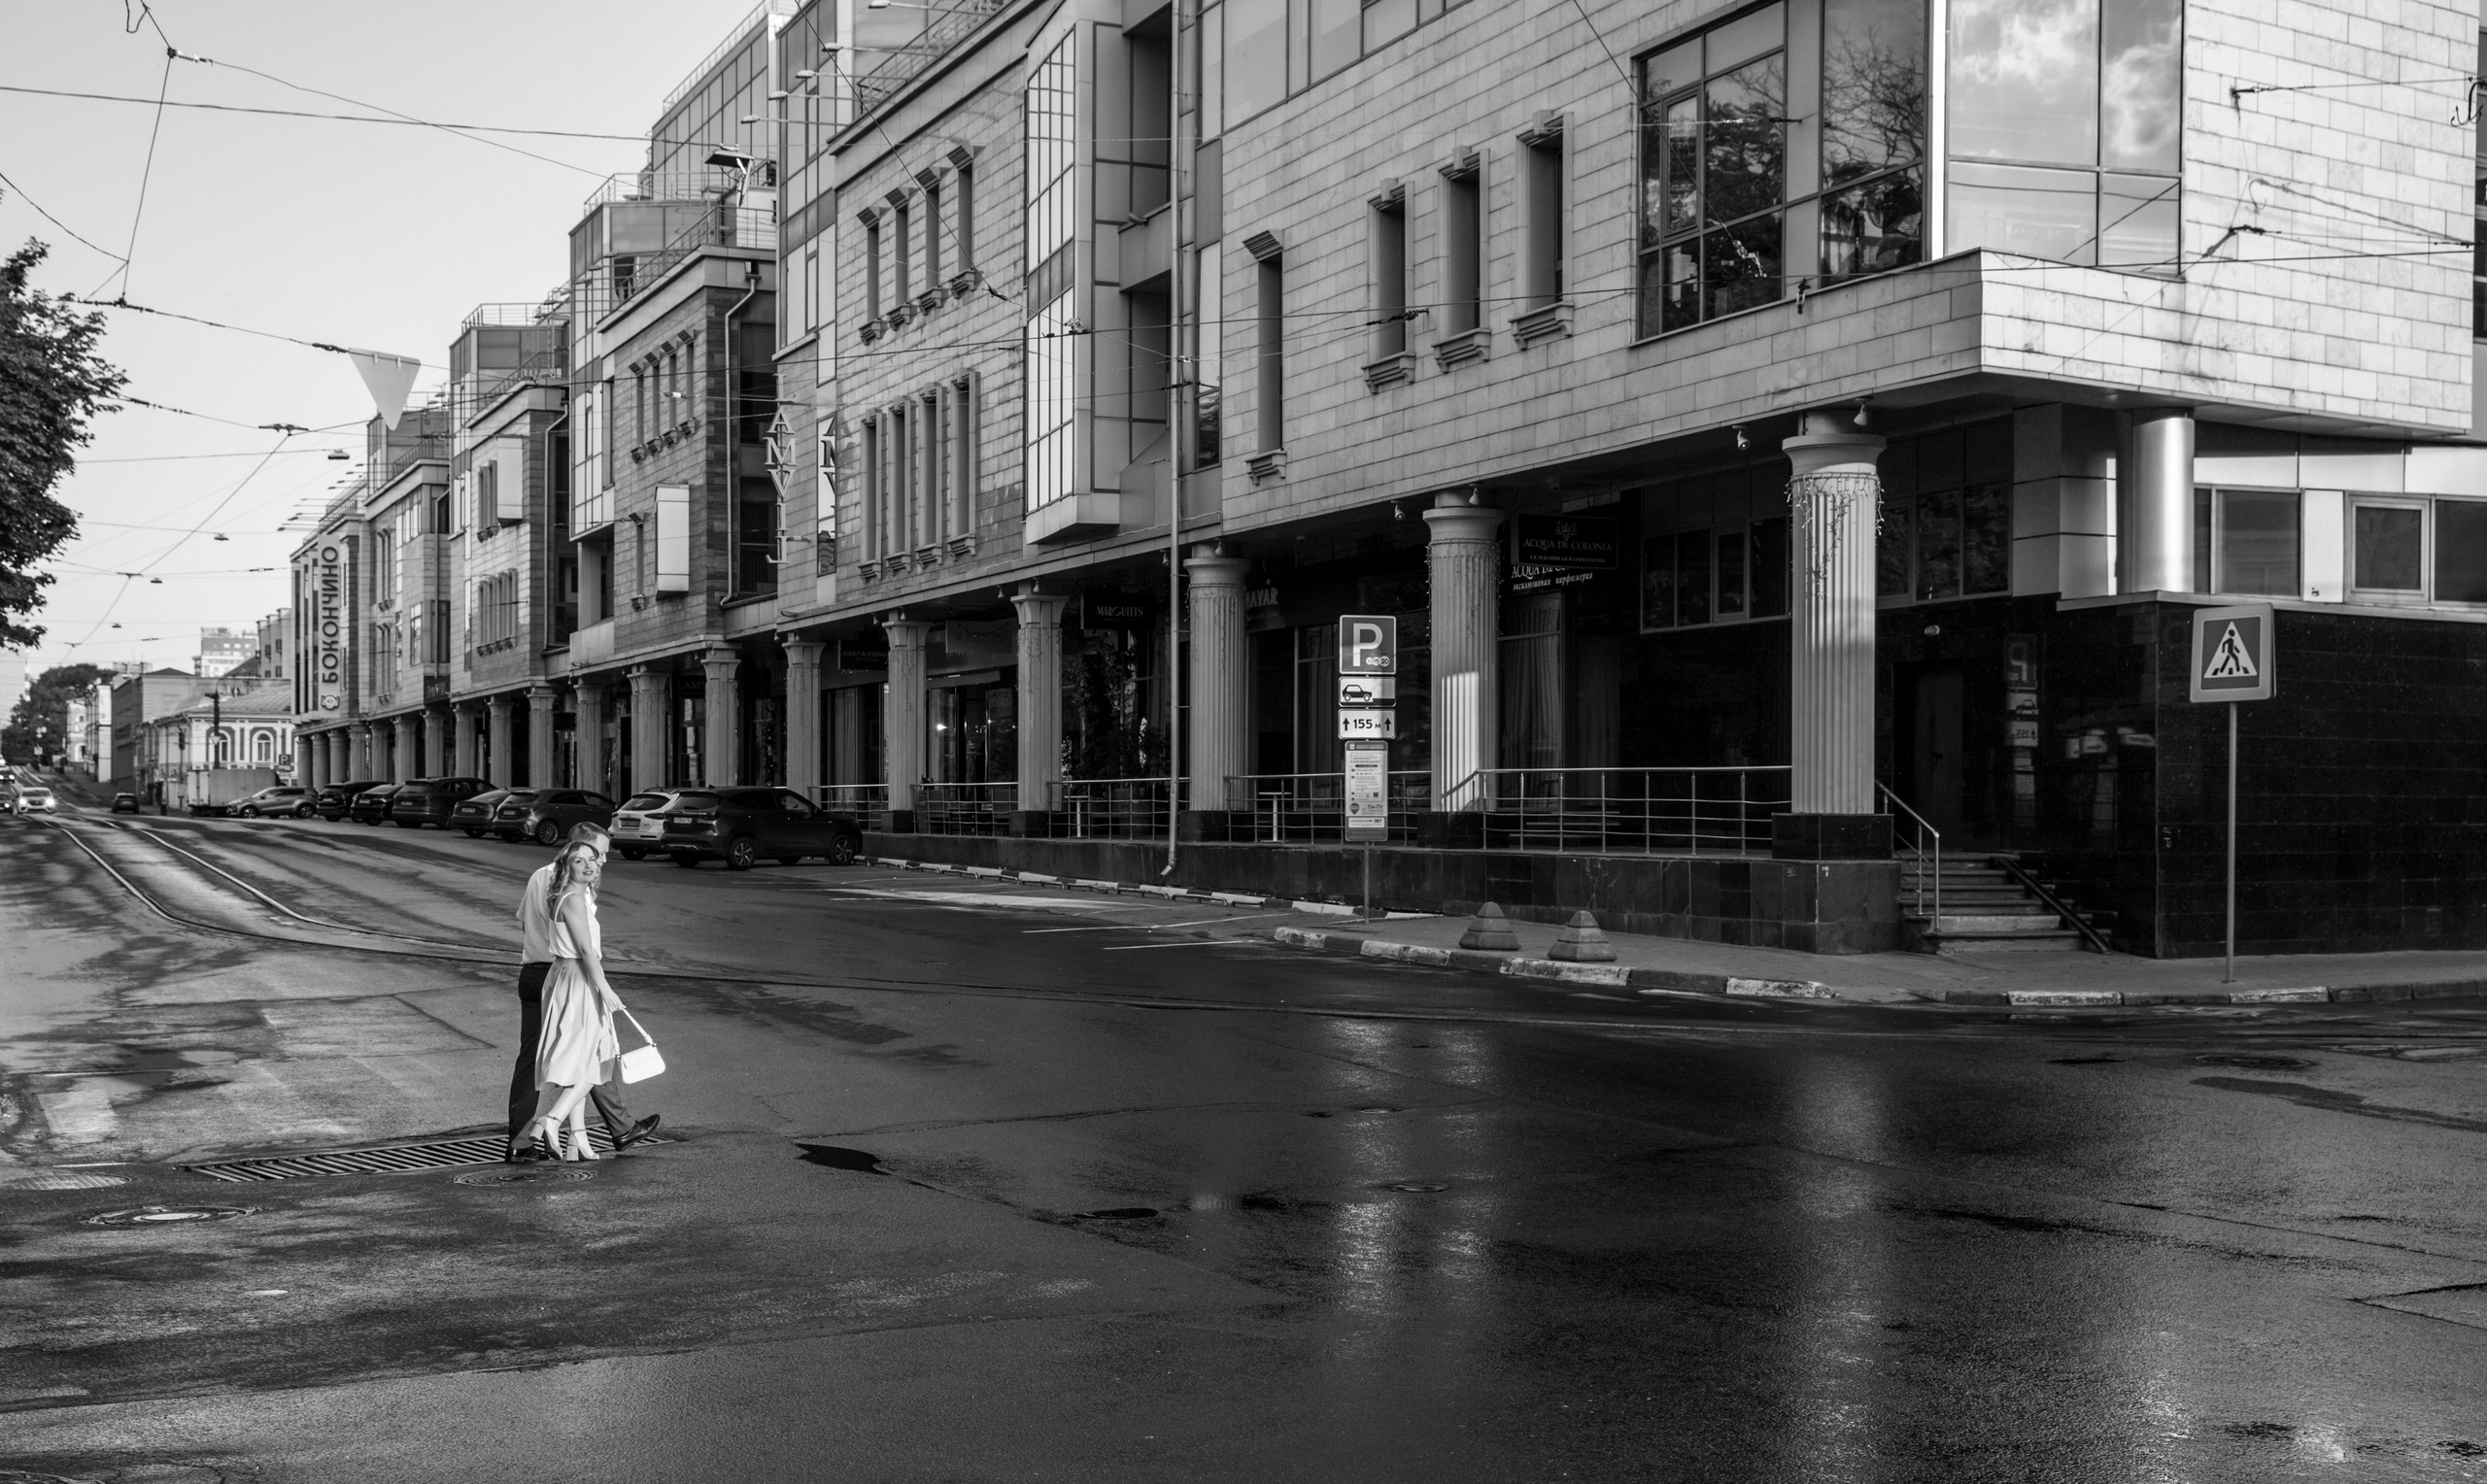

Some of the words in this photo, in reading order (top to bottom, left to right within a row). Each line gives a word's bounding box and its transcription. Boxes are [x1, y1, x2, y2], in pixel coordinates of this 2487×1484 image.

[1523, 538, 1554, 551] ACQUA
[1571, 541, 1612, 551] COLONIA
[322, 546, 339, 684] БОКОНЧИНО
[1352, 623, 1383, 667] P
[1352, 718, 1374, 729] 155
